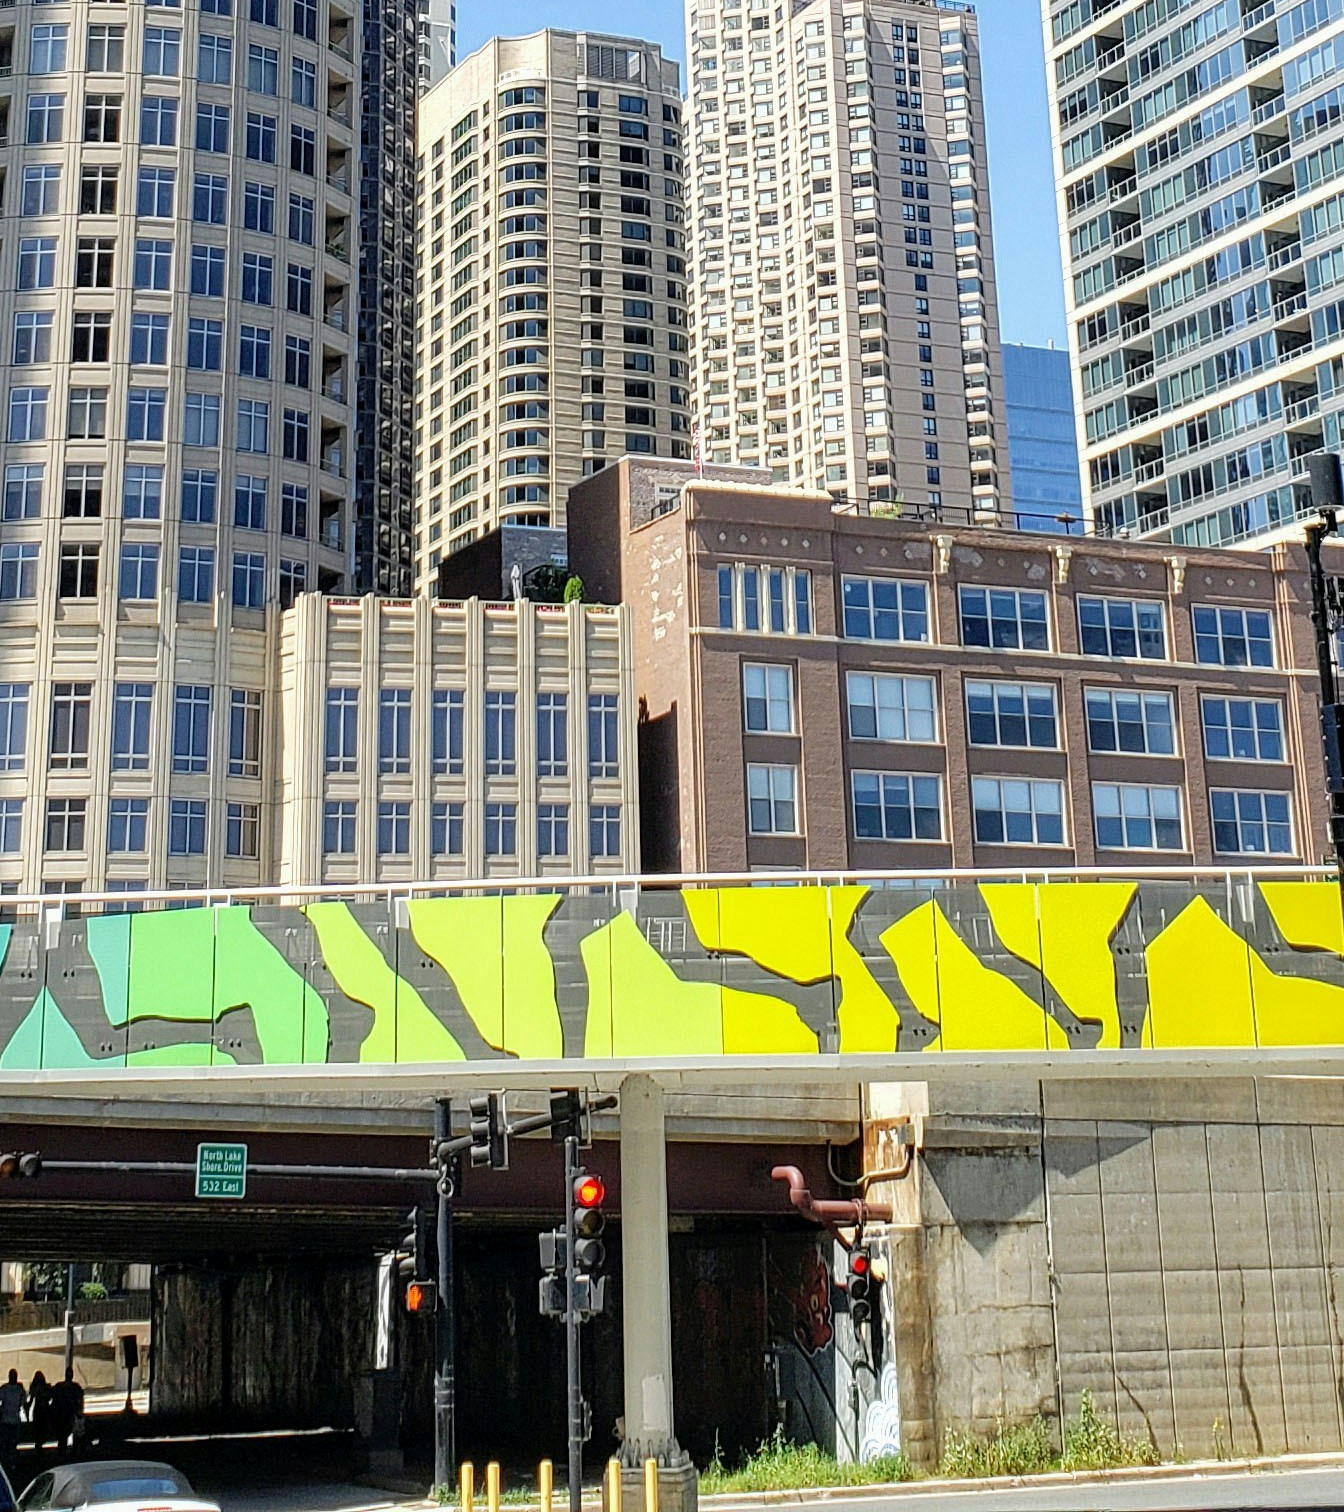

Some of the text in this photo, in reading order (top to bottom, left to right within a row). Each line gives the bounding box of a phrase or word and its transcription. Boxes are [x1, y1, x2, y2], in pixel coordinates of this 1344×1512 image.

[203, 1150, 241, 1161] North Lake
[201, 1161, 242, 1173] Shore Drive
[202, 1180, 239, 1192] 532 East
